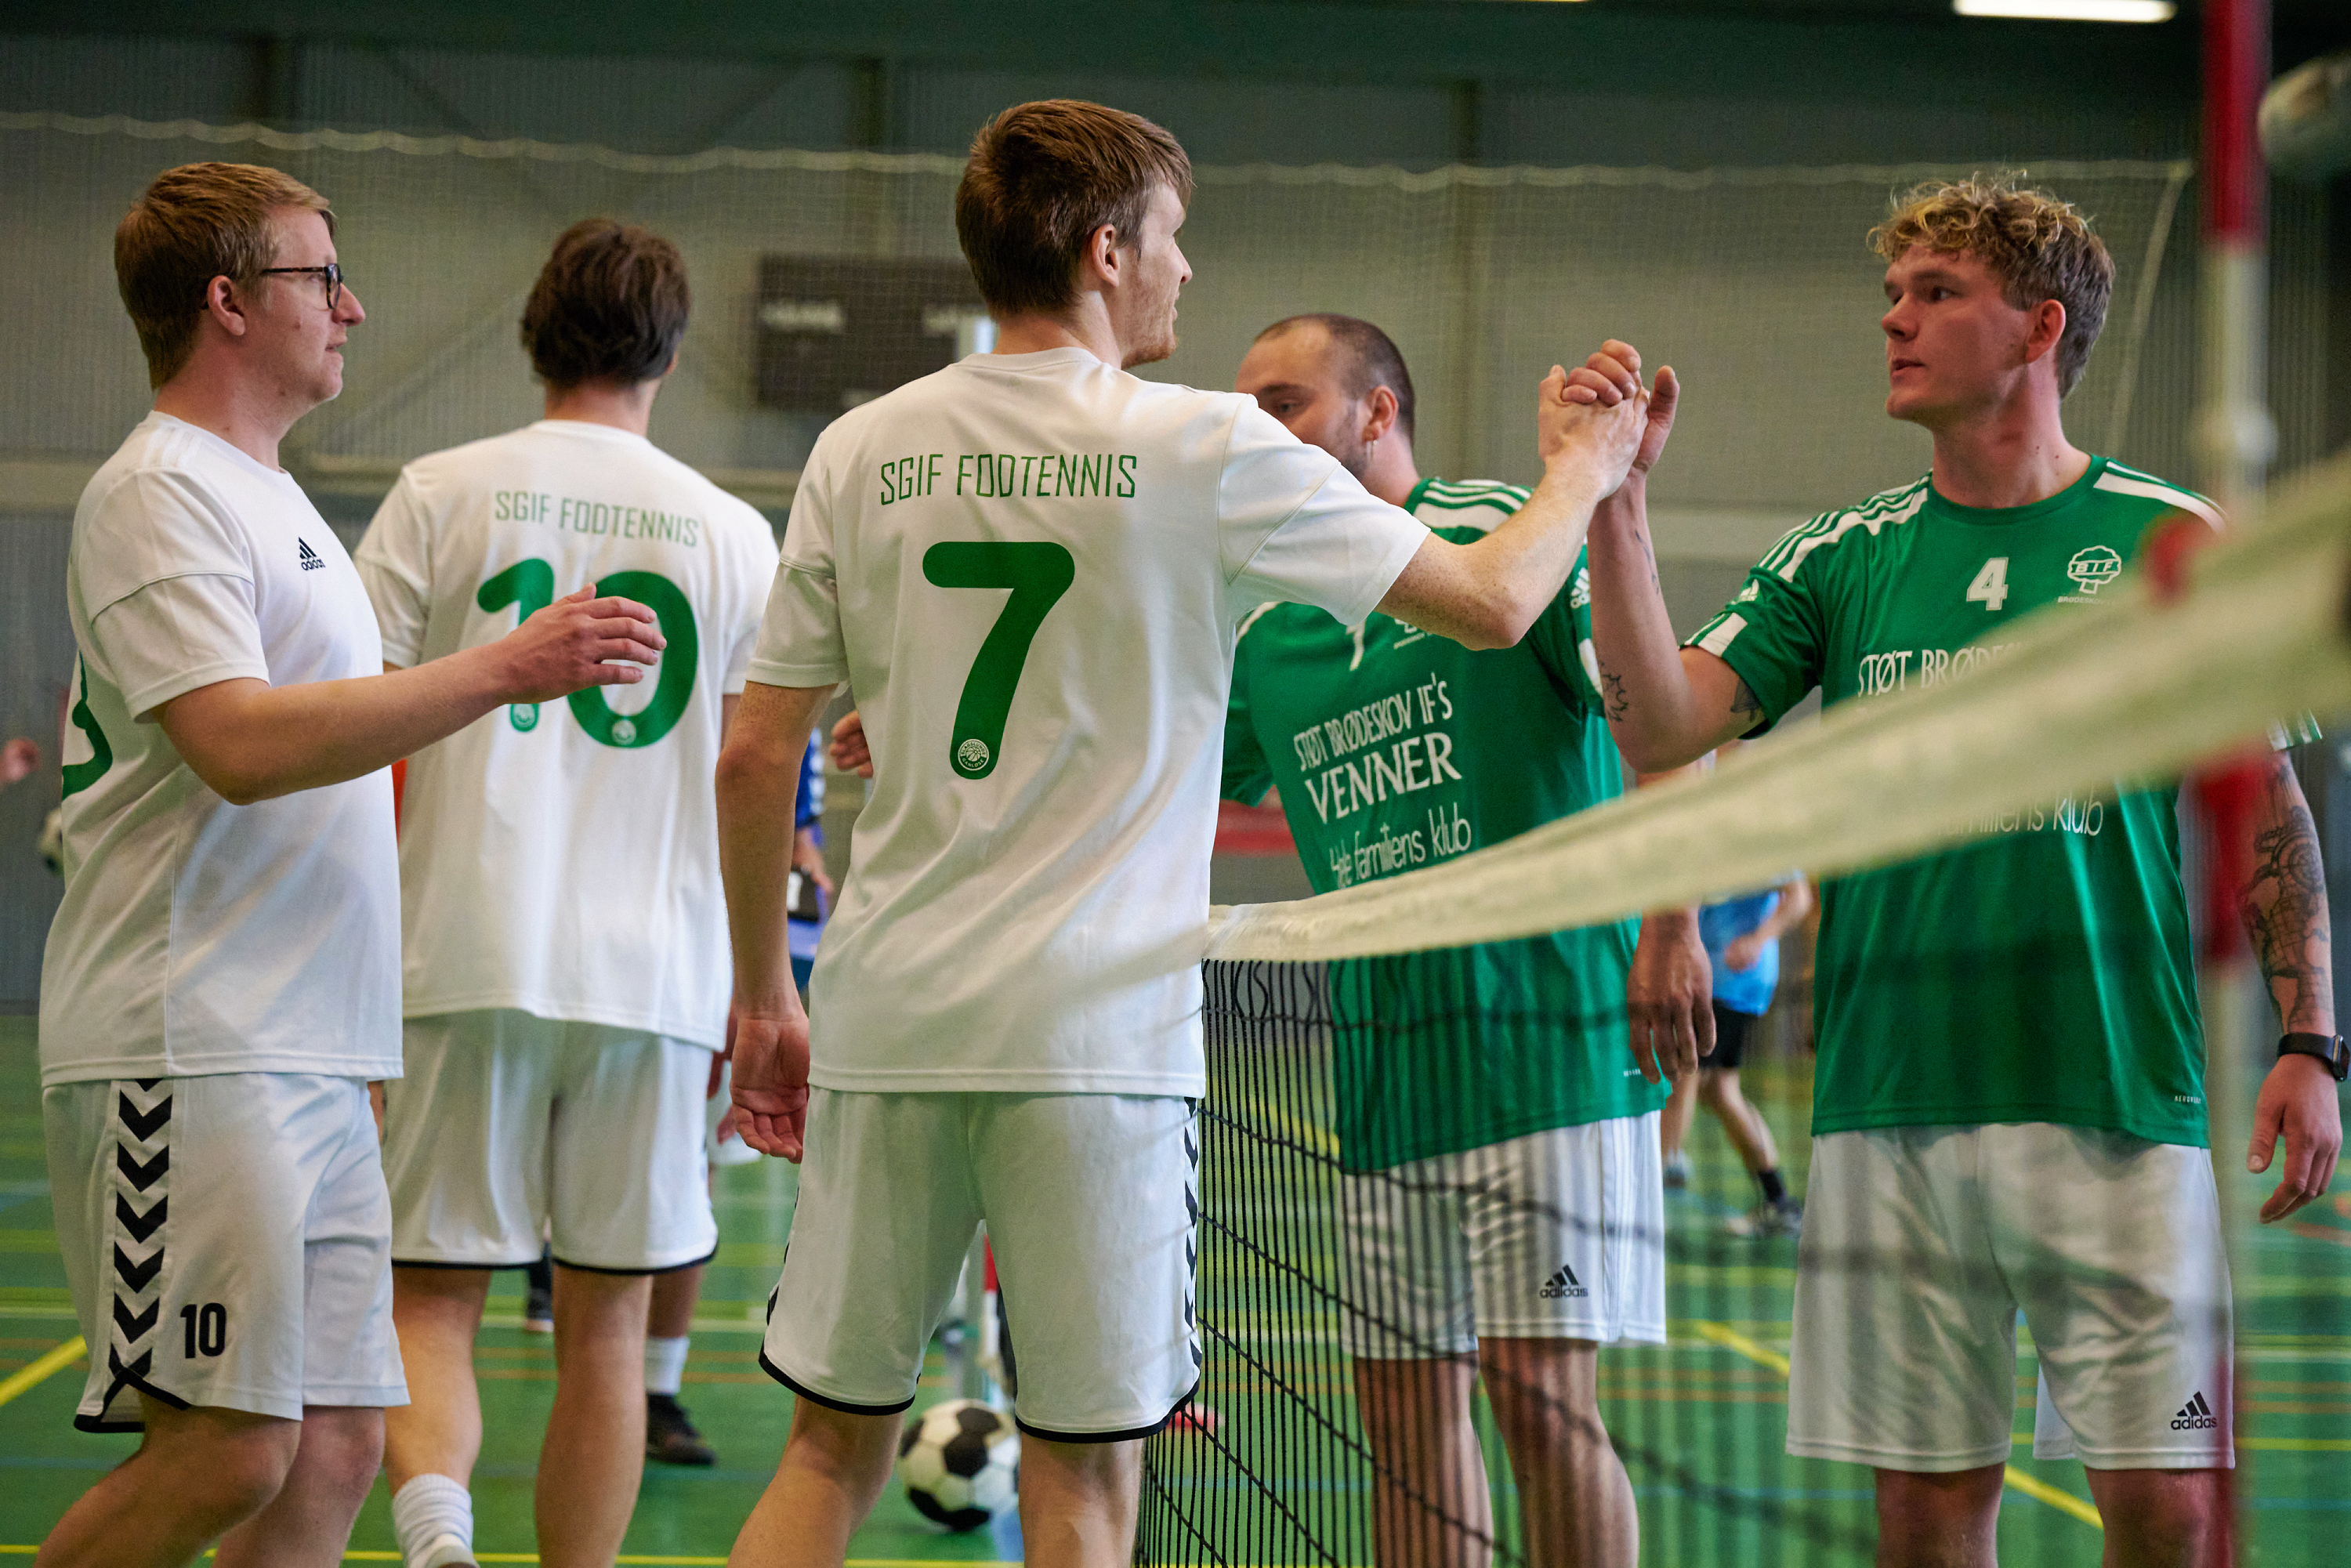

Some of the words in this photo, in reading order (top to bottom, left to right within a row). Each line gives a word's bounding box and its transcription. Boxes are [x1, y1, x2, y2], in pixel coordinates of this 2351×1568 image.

[880, 454, 943, 505] SGIF
[957, 454, 1137, 498] FODTENNIS
[495, 491, 550, 523] SGIF
[560, 497, 698, 547] FODTENNIS
[1966, 556, 2009, 610] 4
[2076, 562, 2114, 573] BIF
[477, 558, 697, 748] 10
[922, 541, 1075, 780] 7
[1858, 650, 1913, 697] STØT
[1293, 725, 1328, 772] STØT
[1324, 690, 1411, 757] BRØDESKOV
[1416, 672, 1453, 725] IF'S
[1305, 732, 1462, 824] VENNER
[1428, 802, 1472, 858] klub
[2053, 782, 2103, 836] klub
[1540, 1285, 1588, 1298] adidas
[179, 1302, 227, 1359] 10
[2170, 1415, 2217, 1430] adidas
